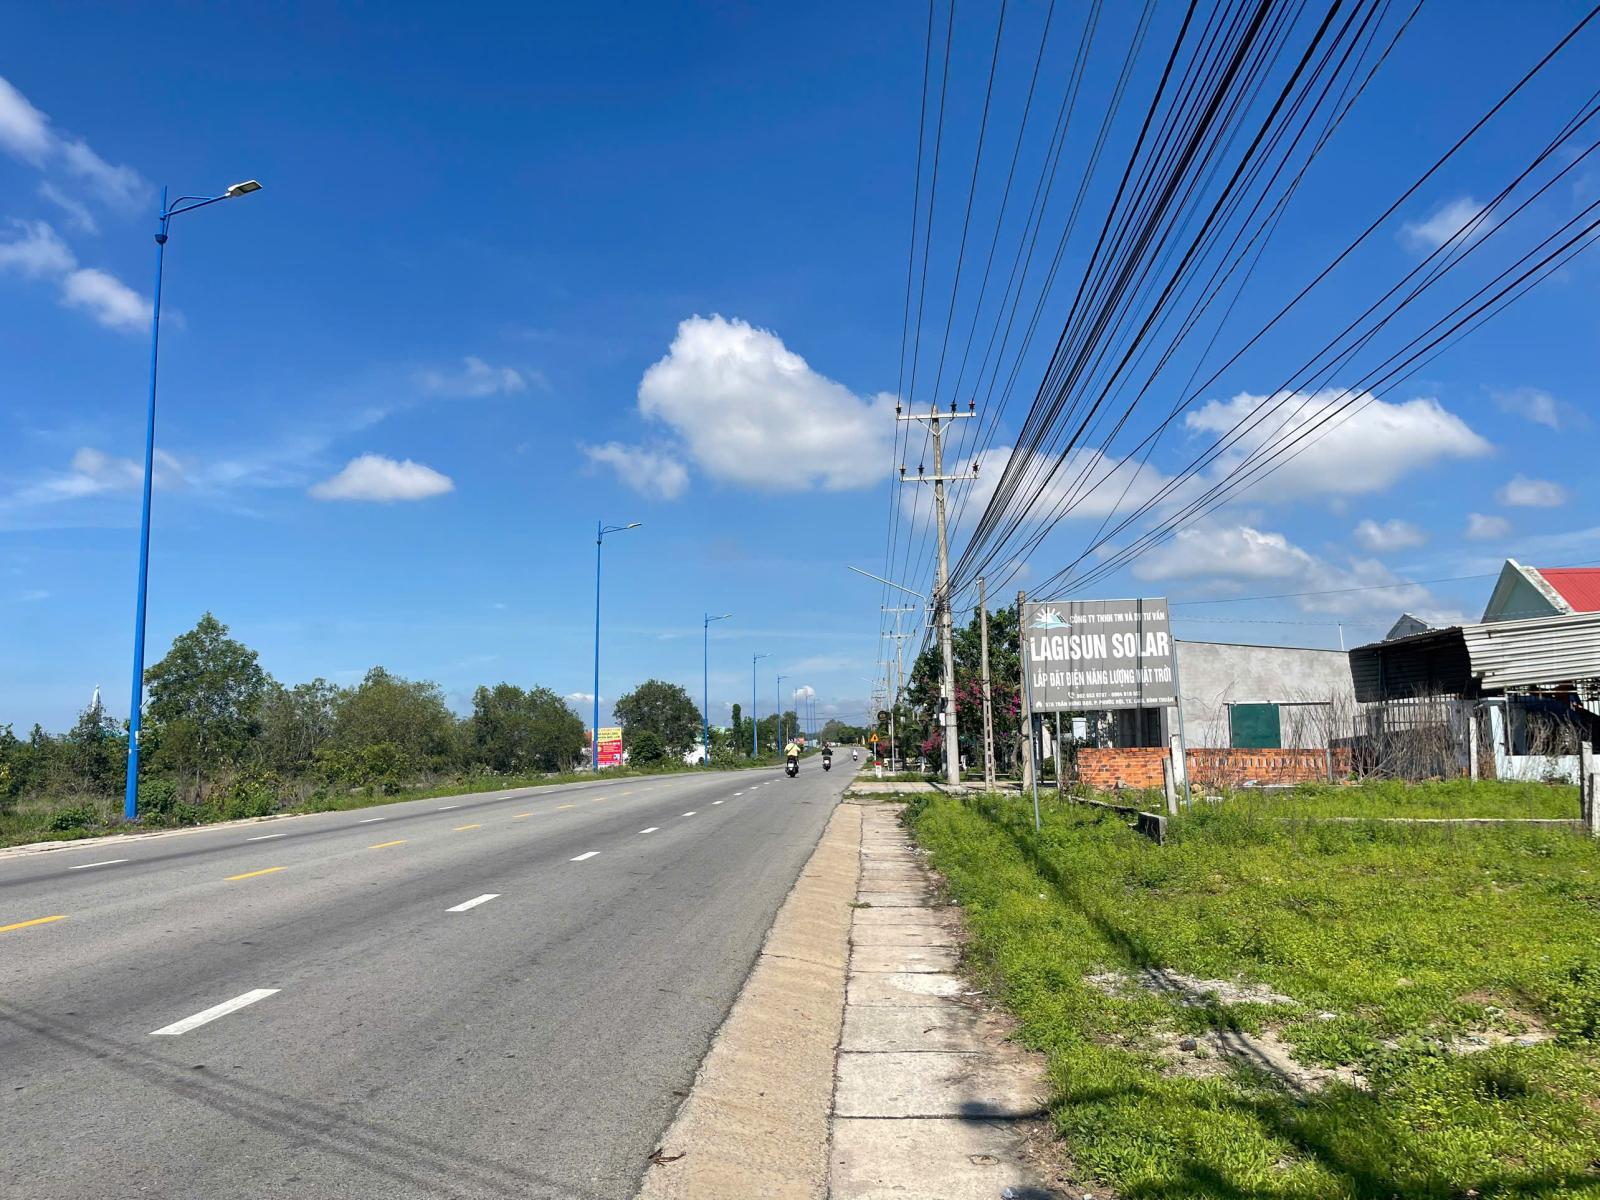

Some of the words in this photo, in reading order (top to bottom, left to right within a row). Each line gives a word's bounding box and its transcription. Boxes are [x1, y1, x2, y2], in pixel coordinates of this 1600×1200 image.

[1070, 613, 1086, 624] CÔNG
[1088, 614, 1095, 623] TY
[1096, 614, 1113, 623] TNHH
[1114, 613, 1123, 622] TM
[1124, 612, 1133, 621] VÀ
[1030, 634, 1107, 661] LAGISUN
[1112, 632, 1169, 658] SOLAR
[1049, 670, 1064, 690] ĐẶT
[1066, 669, 1084, 688] ĐIỆN
[1086, 668, 1108, 685] NĂNG
[1109, 669, 1134, 687] LƯỢNG
[1154, 664, 1172, 683] TRỜI
